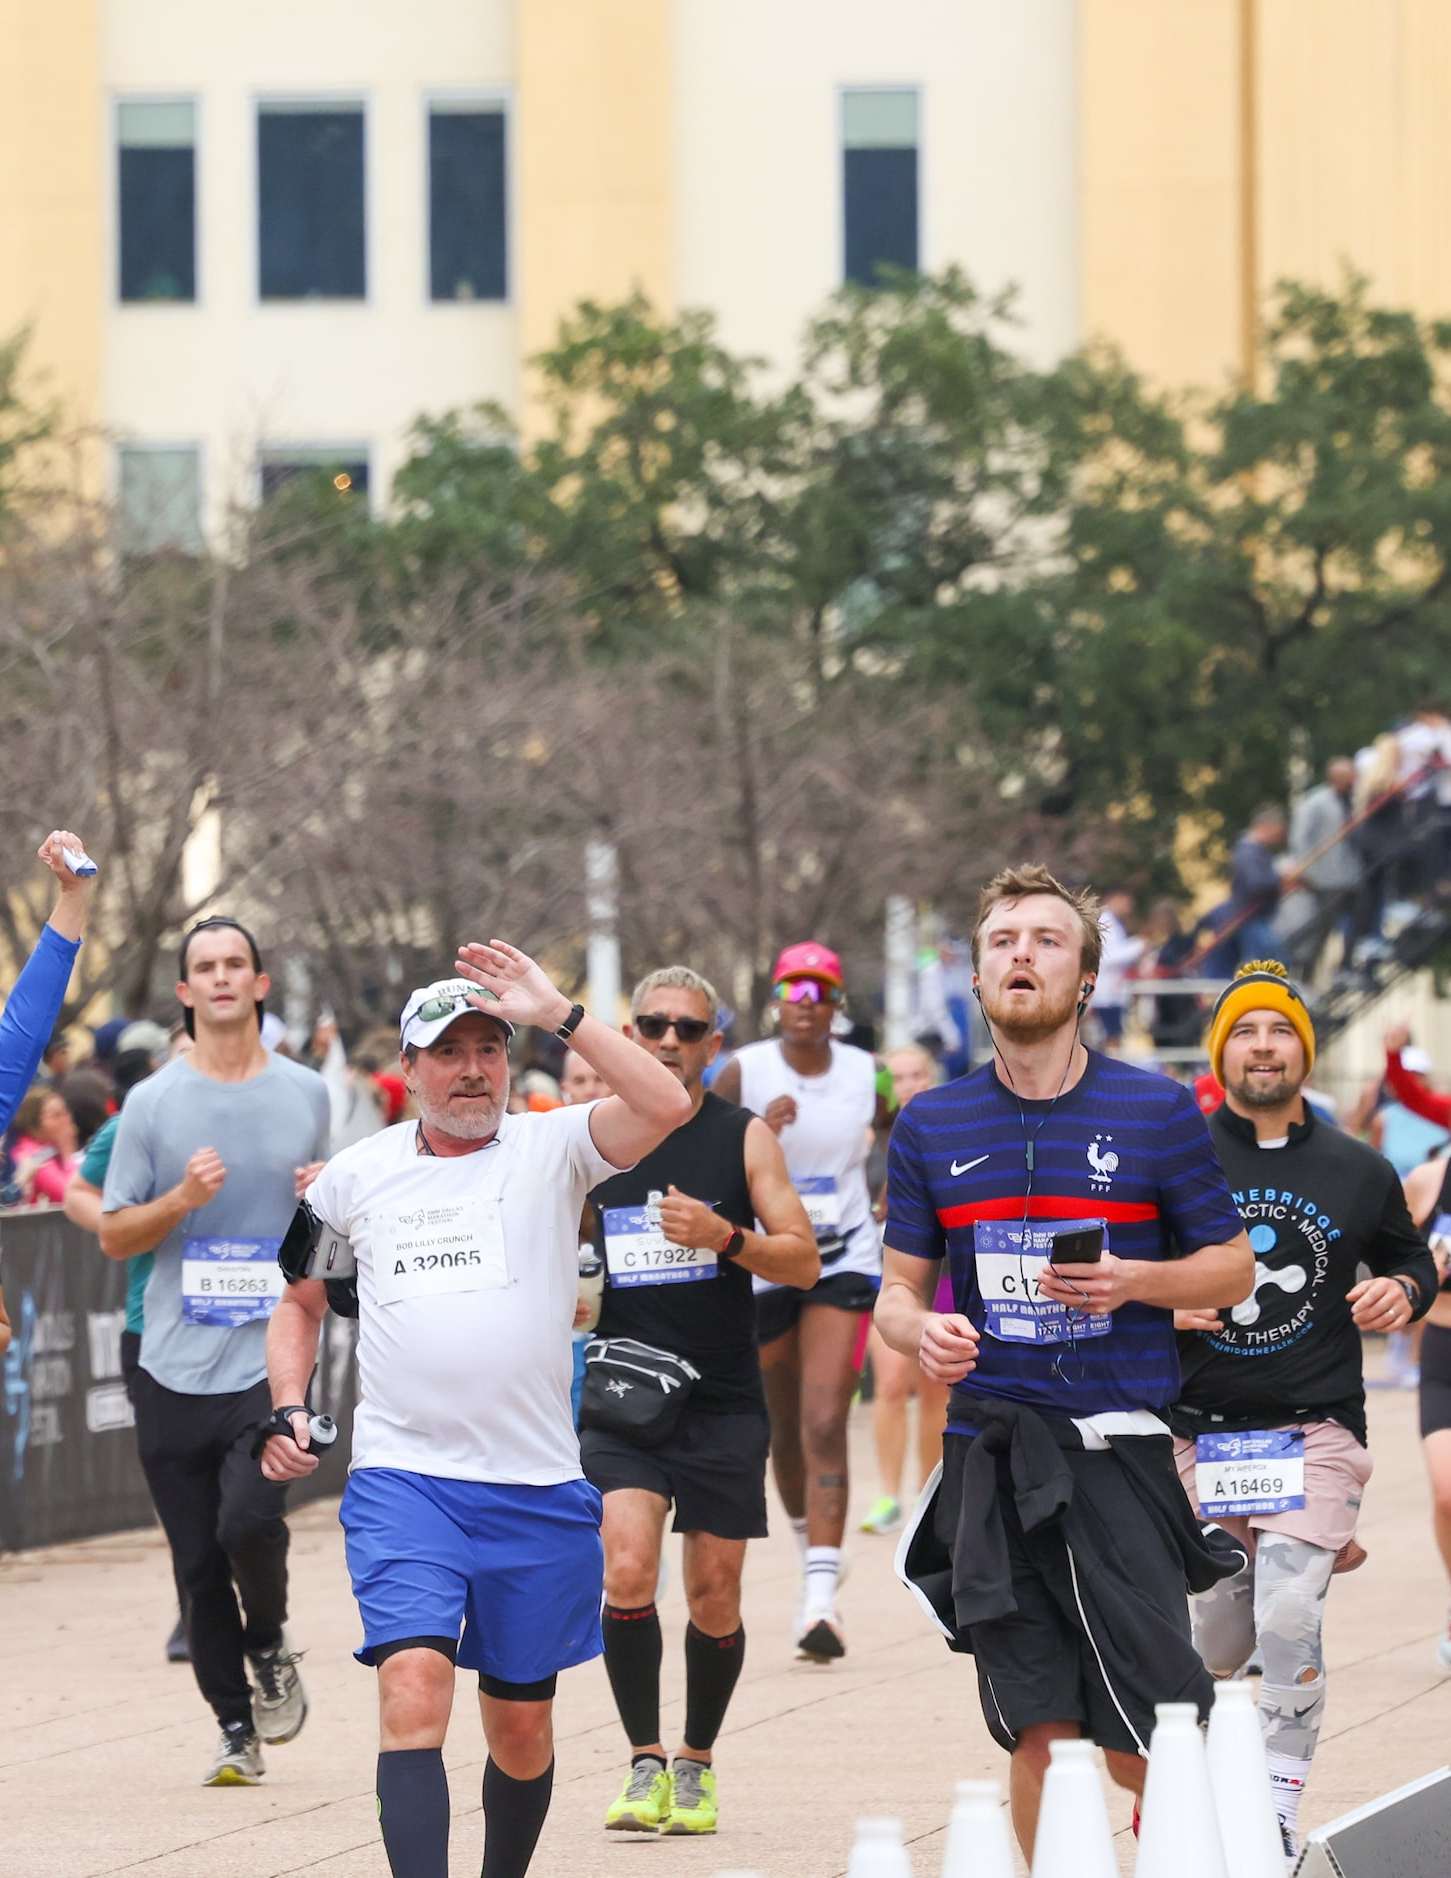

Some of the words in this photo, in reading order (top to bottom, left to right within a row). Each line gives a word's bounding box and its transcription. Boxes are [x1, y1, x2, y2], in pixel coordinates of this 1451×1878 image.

[427, 1212, 460, 1220] MARATHON
[1232, 1188, 1342, 1241] NEBRIDGE
[396, 1241, 414, 1251] BOB
[415, 1239, 436, 1248] LILLY
[437, 1234, 474, 1245] CRUNCH
[1237, 1203, 1288, 1220] ACTIC
[1298, 1219, 1329, 1287] MEDICAL
[394, 1259, 407, 1276] A
[413, 1250, 482, 1272] 32065
[624, 1252, 636, 1267] C
[643, 1248, 697, 1266] 17922
[201, 1279, 212, 1292] B
[219, 1279, 268, 1292] 16263
[1002, 1275, 1016, 1293] C
[992, 1303, 1017, 1313] HALF
[1245, 1301, 1315, 1345] THERAPY
[1215, 1480, 1226, 1496] A
[1230, 1478, 1283, 1495] 16469
